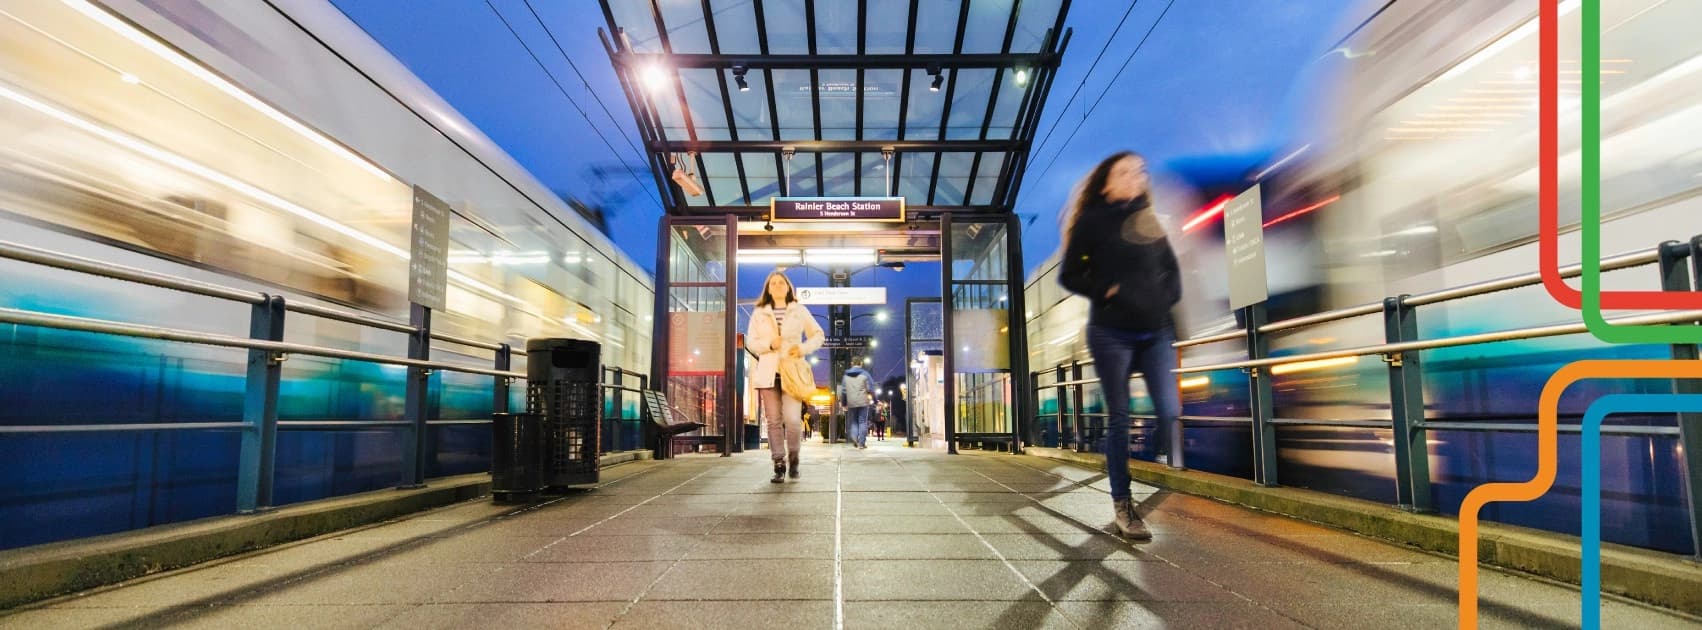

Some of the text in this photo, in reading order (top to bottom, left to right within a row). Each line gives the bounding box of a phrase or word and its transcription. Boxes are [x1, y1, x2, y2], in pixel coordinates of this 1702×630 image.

[795, 202, 881, 210] Rainier Beach Station
